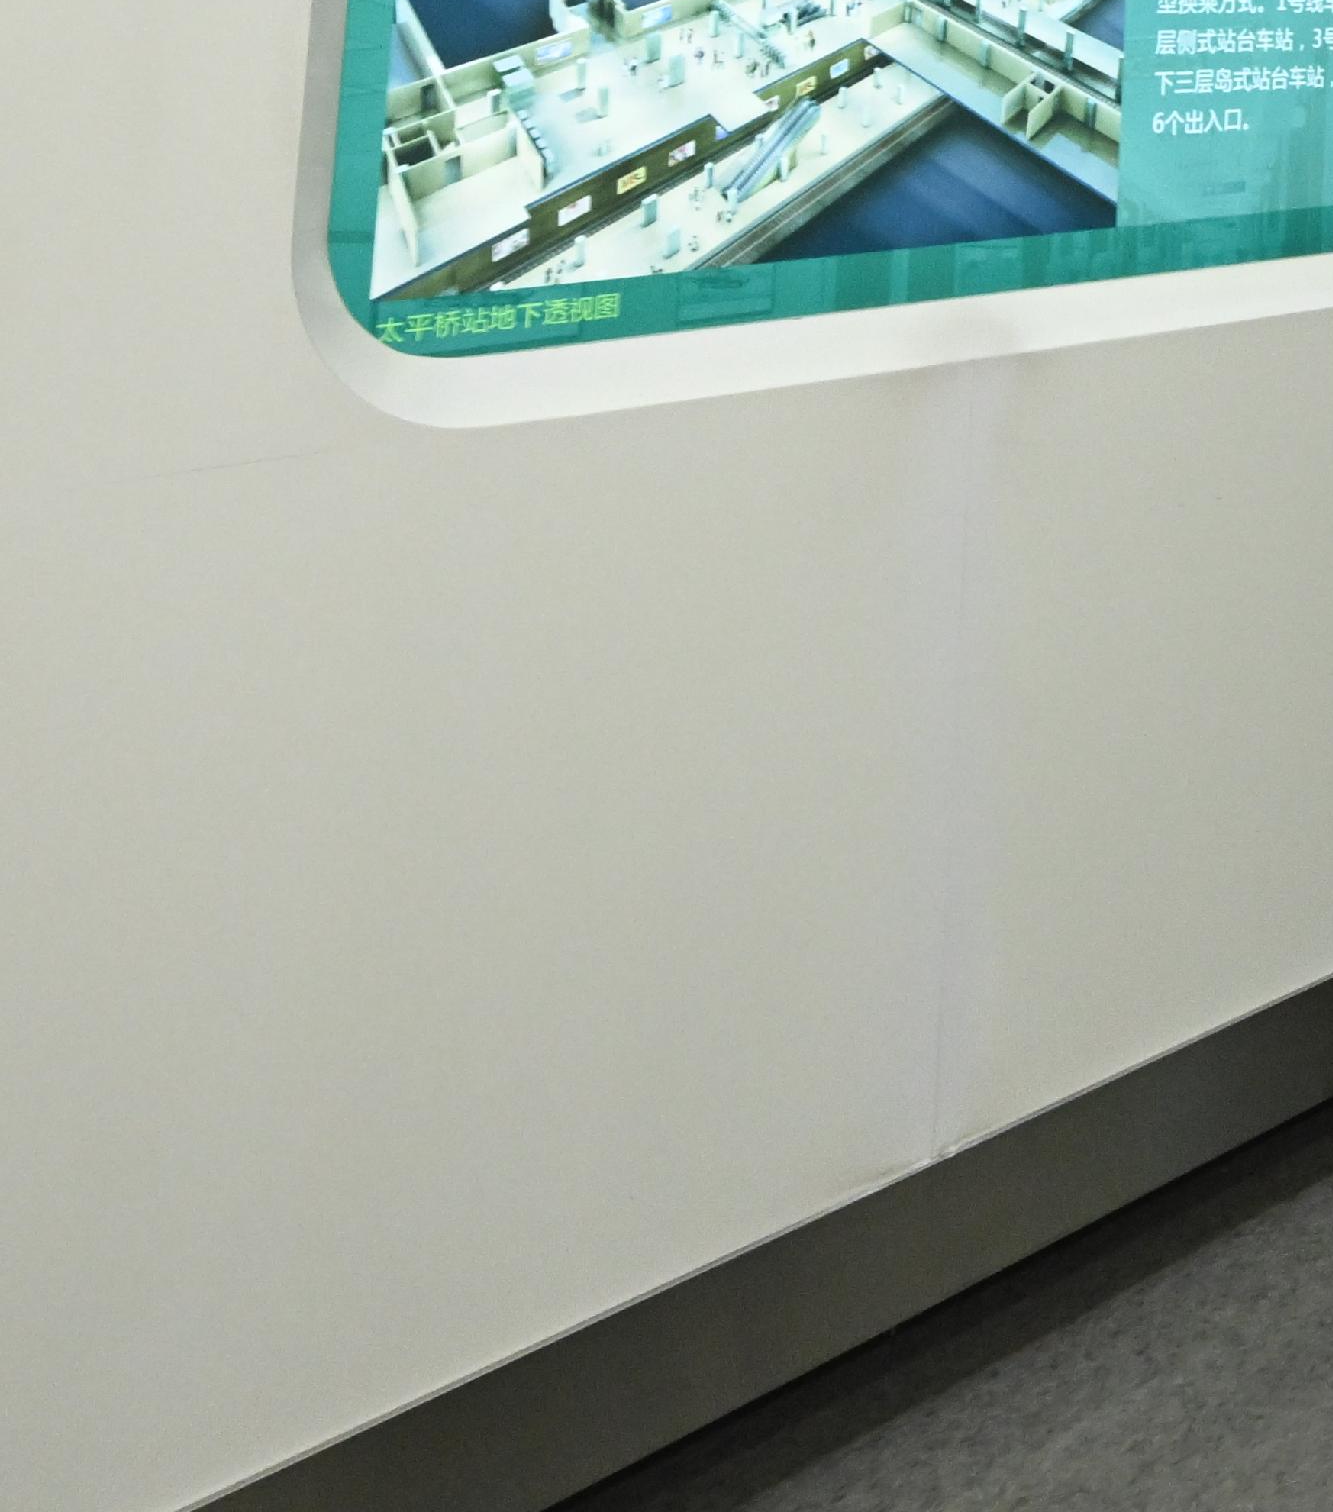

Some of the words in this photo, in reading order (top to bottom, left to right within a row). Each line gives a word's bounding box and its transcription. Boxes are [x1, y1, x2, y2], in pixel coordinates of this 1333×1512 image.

[1152, 109, 1250, 136] 6个出入口。
[376, 292, 622, 344] 太平桥站地下透视图
